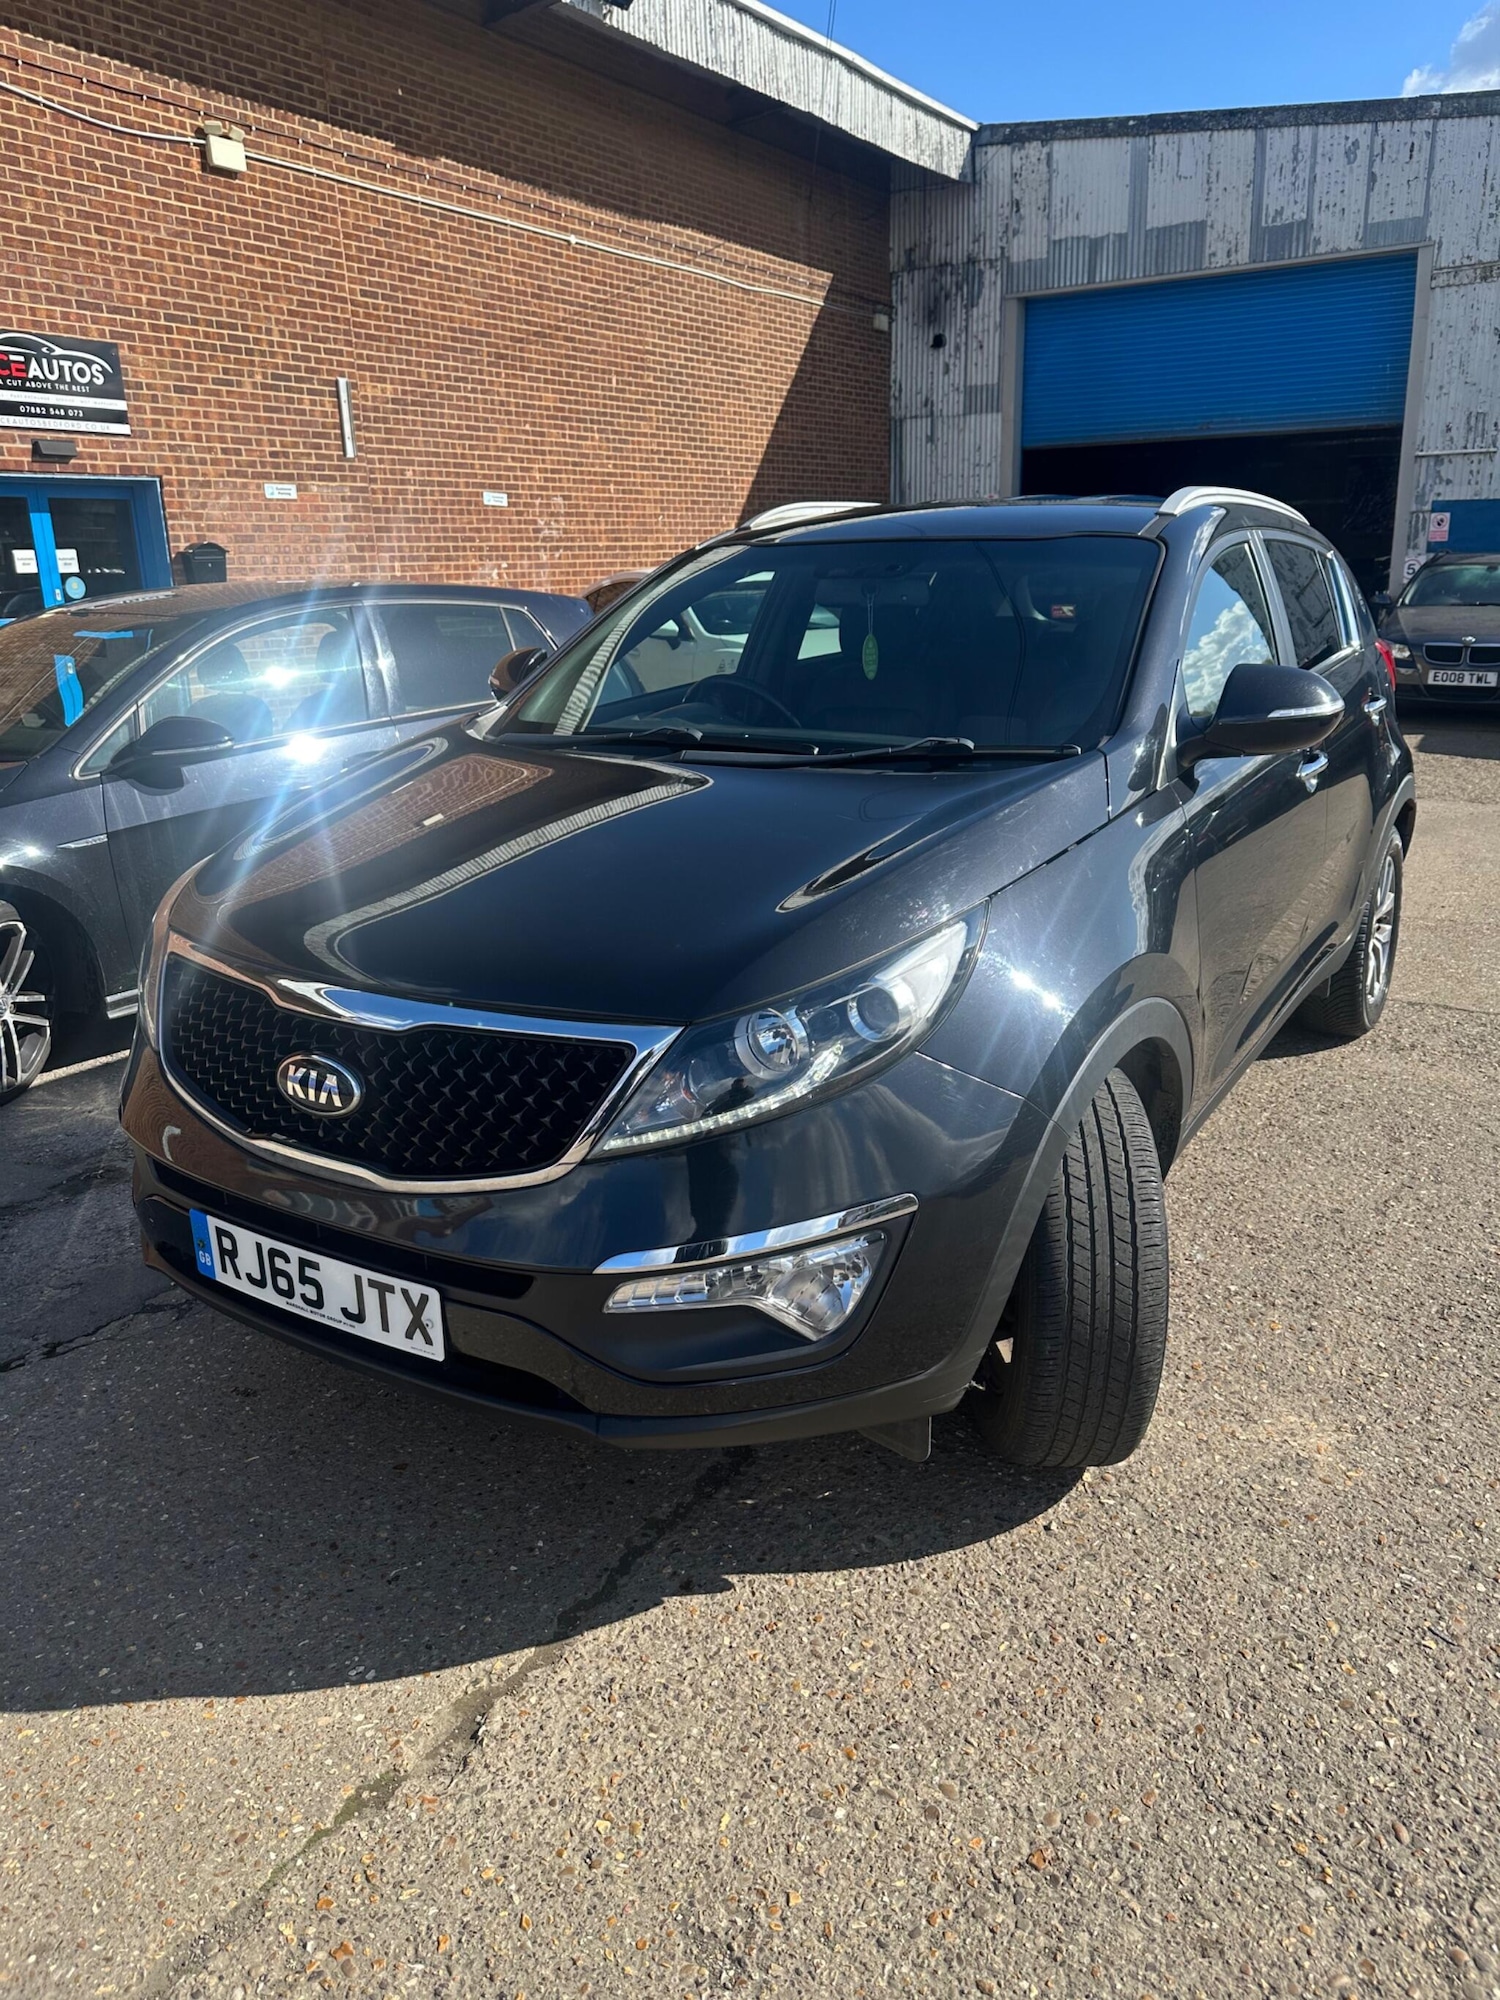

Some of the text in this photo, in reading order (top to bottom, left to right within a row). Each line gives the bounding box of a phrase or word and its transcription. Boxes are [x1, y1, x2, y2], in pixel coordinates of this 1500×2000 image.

[6, 378, 22, 387] CUT
[25, 381, 52, 390] ABOVE
[55, 383, 69, 391] THE
[71, 385, 90, 393] REST
[19, 405, 46, 415] 07882
[68, 408, 84, 417] 073
[1406, 563, 1417, 575] 5
[1469, 672, 1492, 684] TWL
[287, 1064, 343, 1107] KIA
[199, 1250, 212, 1267] GB
[215, 1226, 434, 1347] RJ65 JTX
[286, 1301, 342, 1324] MARSHALL MOTOR GROUP
